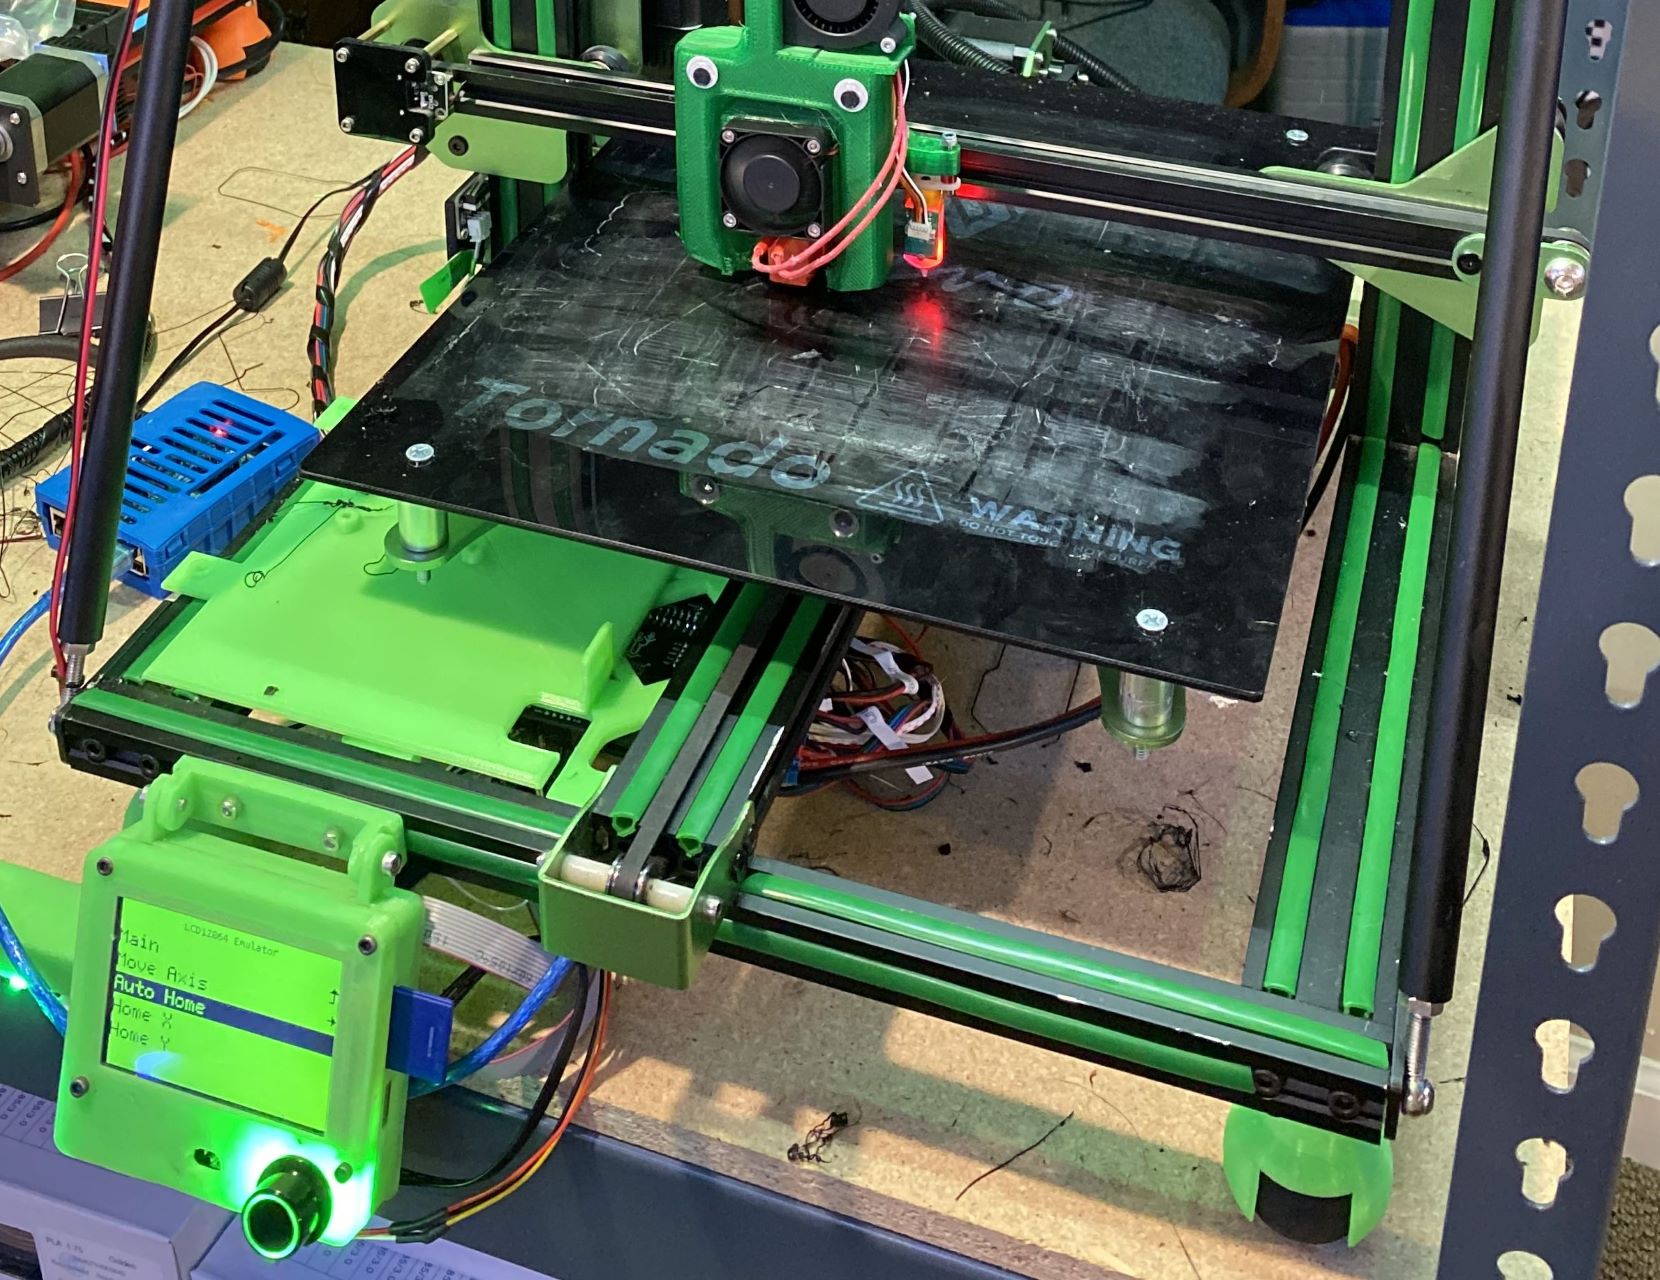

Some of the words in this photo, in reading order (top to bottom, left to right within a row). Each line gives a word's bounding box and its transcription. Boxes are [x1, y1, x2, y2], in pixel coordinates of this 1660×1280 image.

[455, 376, 831, 490] Tornado
[969, 497, 1183, 561] WARNING
[119, 928, 160, 953] Main
[234, 937, 279, 957] Emulator
[117, 951, 157, 976] Move
[167, 966, 208, 991] Axis
[113, 973, 156, 1000] Auto
[163, 988, 207, 1016] Home
[112, 997, 152, 1022] Home
[161, 1011, 173, 1029] X
[110, 1021, 150, 1046] Home
[160, 1034, 171, 1052] Y
